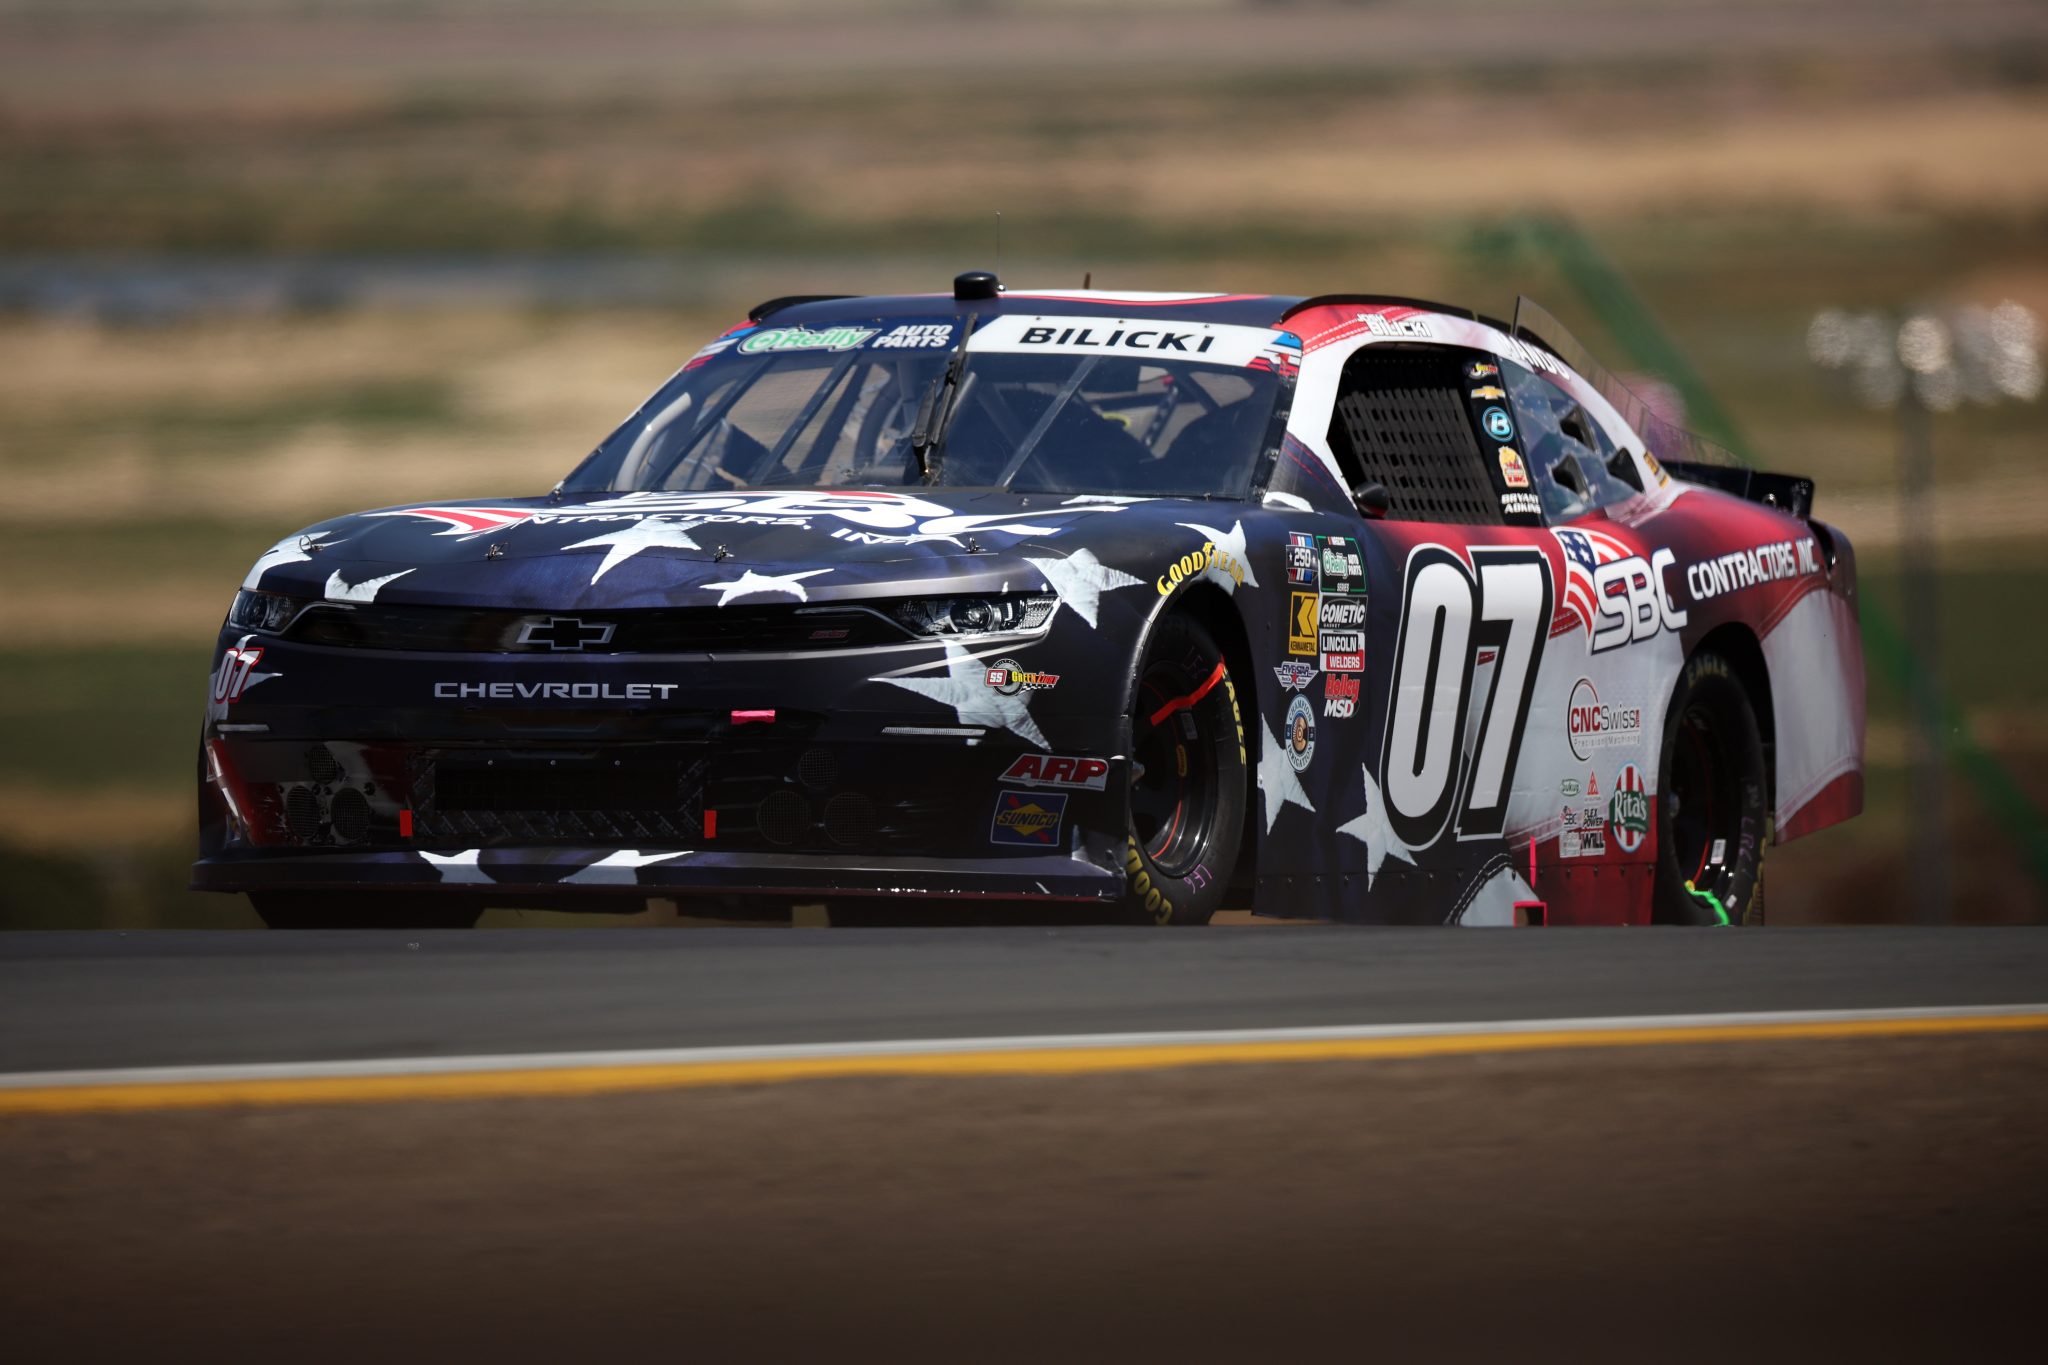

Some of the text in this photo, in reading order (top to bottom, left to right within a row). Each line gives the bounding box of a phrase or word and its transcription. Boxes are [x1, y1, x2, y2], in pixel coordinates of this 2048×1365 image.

[888, 324, 953, 338] AUTO
[1364, 317, 1433, 338] BILICKI
[872, 335, 951, 349] PARTS
[1019, 326, 1216, 354] BILICKI
[1501, 492, 1539, 505] BRYANT
[1293, 547, 1312, 568] 250
[1157, 543, 1244, 596] GOODYEAR
[1592, 548, 1688, 654] SBC
[1321, 604, 1365, 624] COMETIC
[1322, 635, 1357, 652] LINCOLN
[1329, 656, 1361, 669] WELDERS
[1686, 653, 1729, 689] EAGLE
[214, 648, 265, 704] 07
[434, 682, 679, 700] CHEVROLET
[1325, 674, 1360, 703] Holley
[1381, 546, 1553, 849] 07
[1323, 699, 1355, 719] MSD
[1006, 755, 1106, 783] ARP
[1614, 789, 1647, 825] Rita's
[998, 810, 1058, 827] SUNOCO
